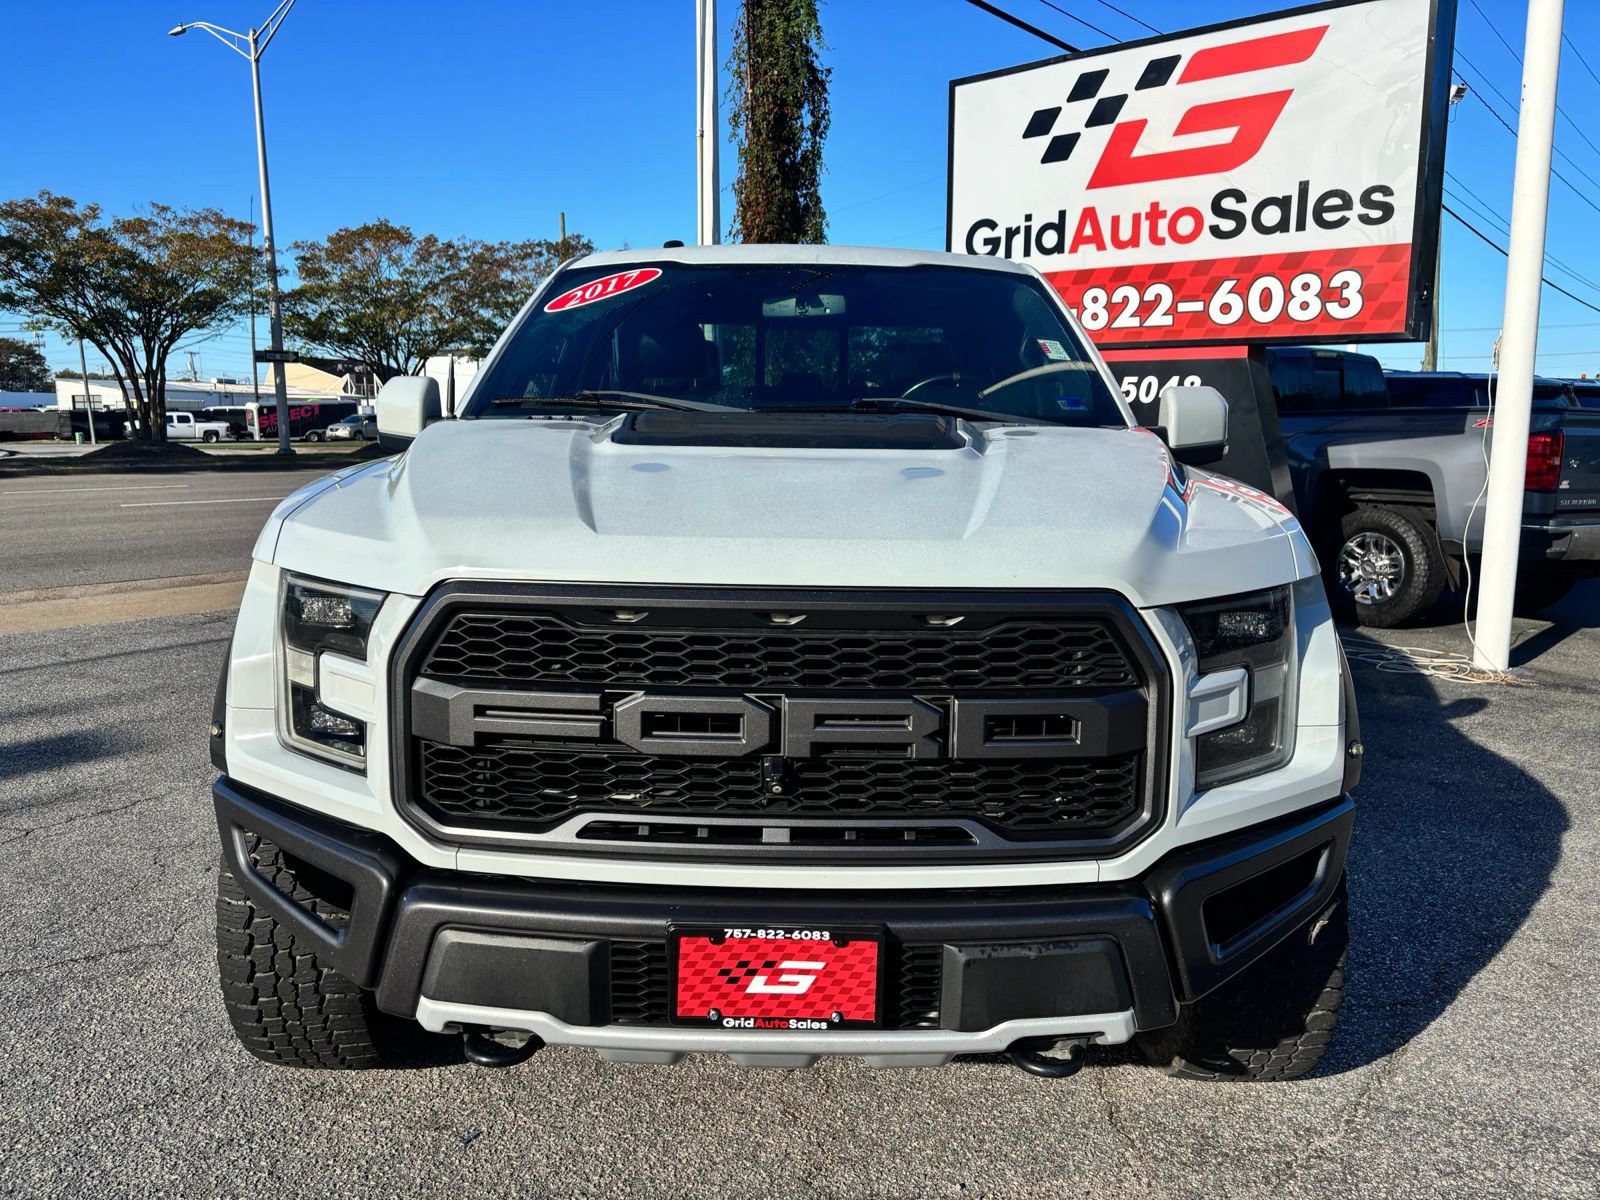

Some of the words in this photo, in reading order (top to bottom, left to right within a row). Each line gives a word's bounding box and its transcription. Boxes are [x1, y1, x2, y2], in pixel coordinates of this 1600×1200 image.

[965, 179, 1396, 259] GridAutoSales
[564, 270, 641, 309] 2017
[1071, 269, 1365, 332] 822-6083
[258, 403, 321, 428] SEECT
[411, 677, 1148, 760] FORD
[723, 929, 830, 940] 757-822-6083
[722, 1018, 828, 1029] GridAutoSales
